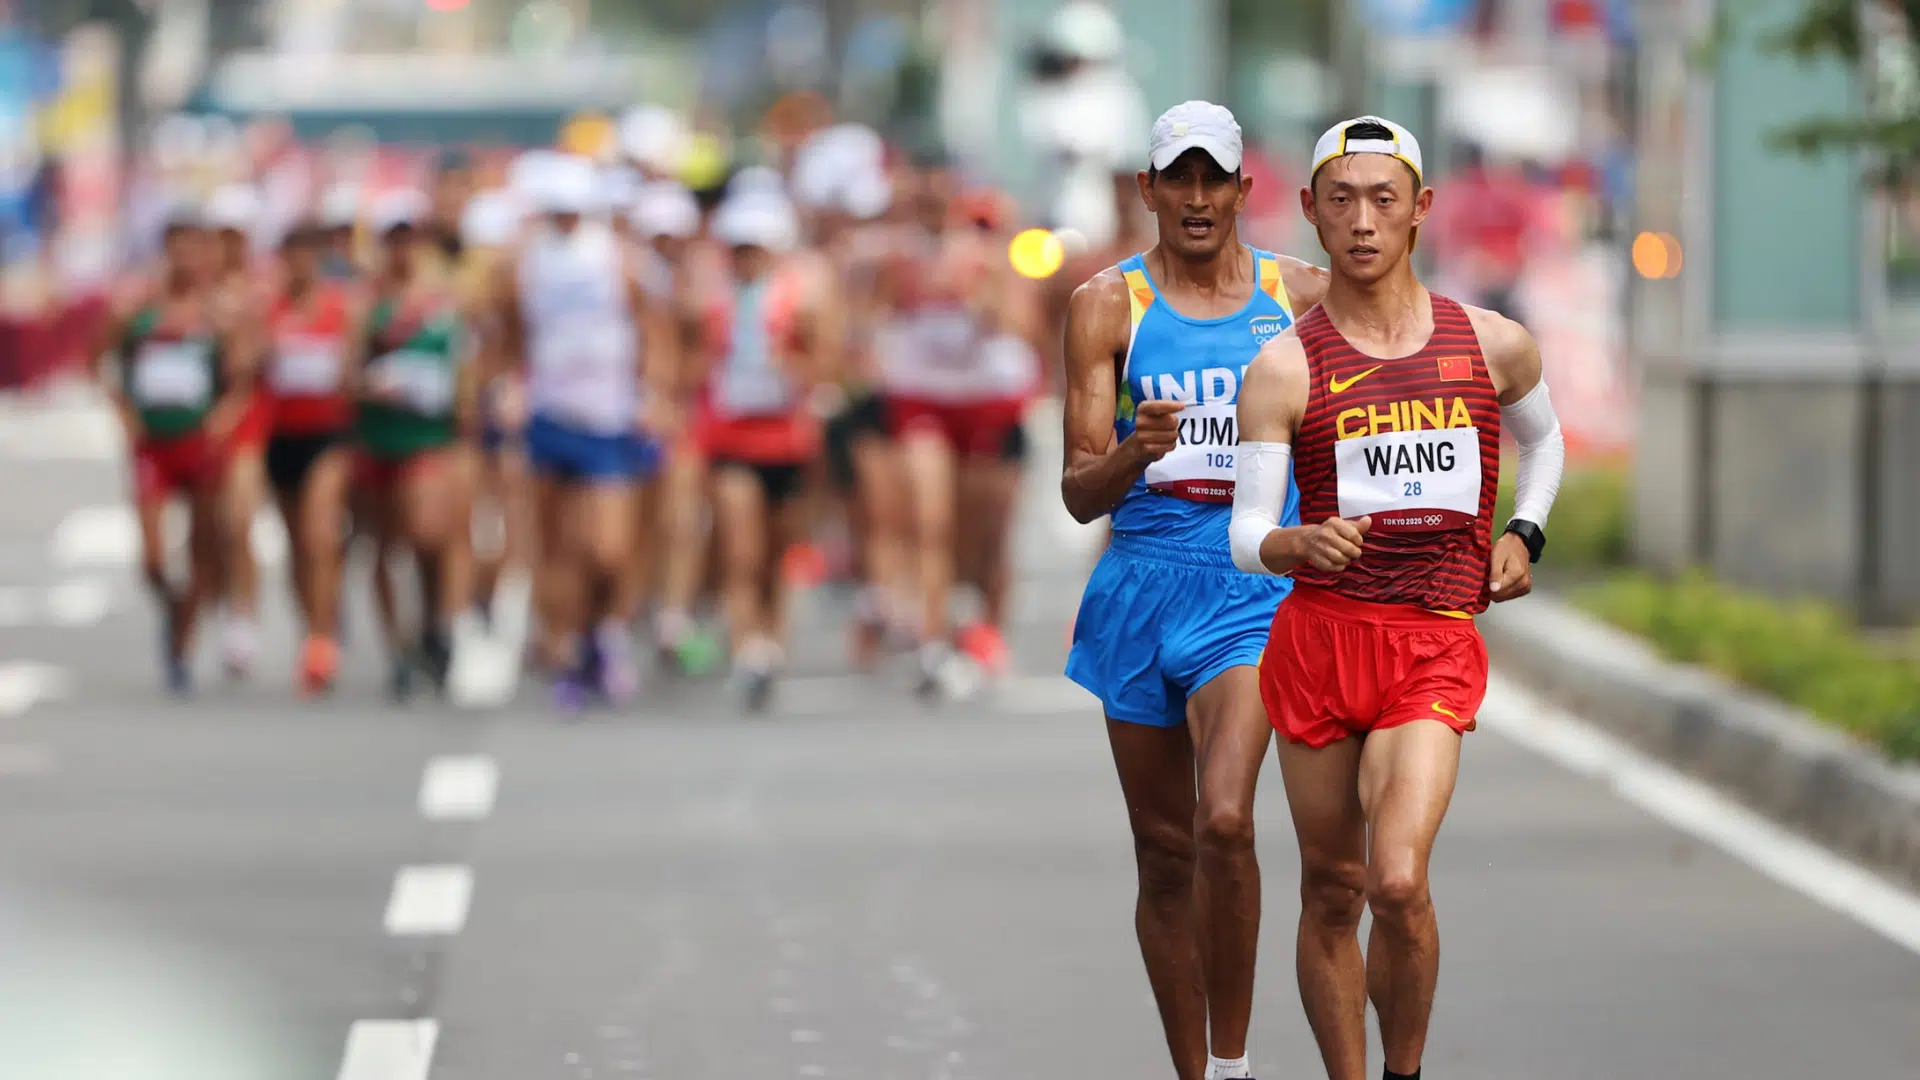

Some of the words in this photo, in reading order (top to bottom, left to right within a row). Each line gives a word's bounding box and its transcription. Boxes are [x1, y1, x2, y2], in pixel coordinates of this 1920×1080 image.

[1252, 323, 1282, 335] INDIA
[1336, 396, 1472, 440] CHINA
[1178, 417, 1240, 446] KUM
[1206, 453, 1234, 468] 102
[1364, 441, 1455, 477] WANG
[1187, 486, 1209, 495] TOKYO
[1209, 488, 1227, 496] 2020
[1403, 481, 1422, 497] 28
[1383, 518, 1406, 526] TOKYO
[1405, 517, 1423, 525] 2020
